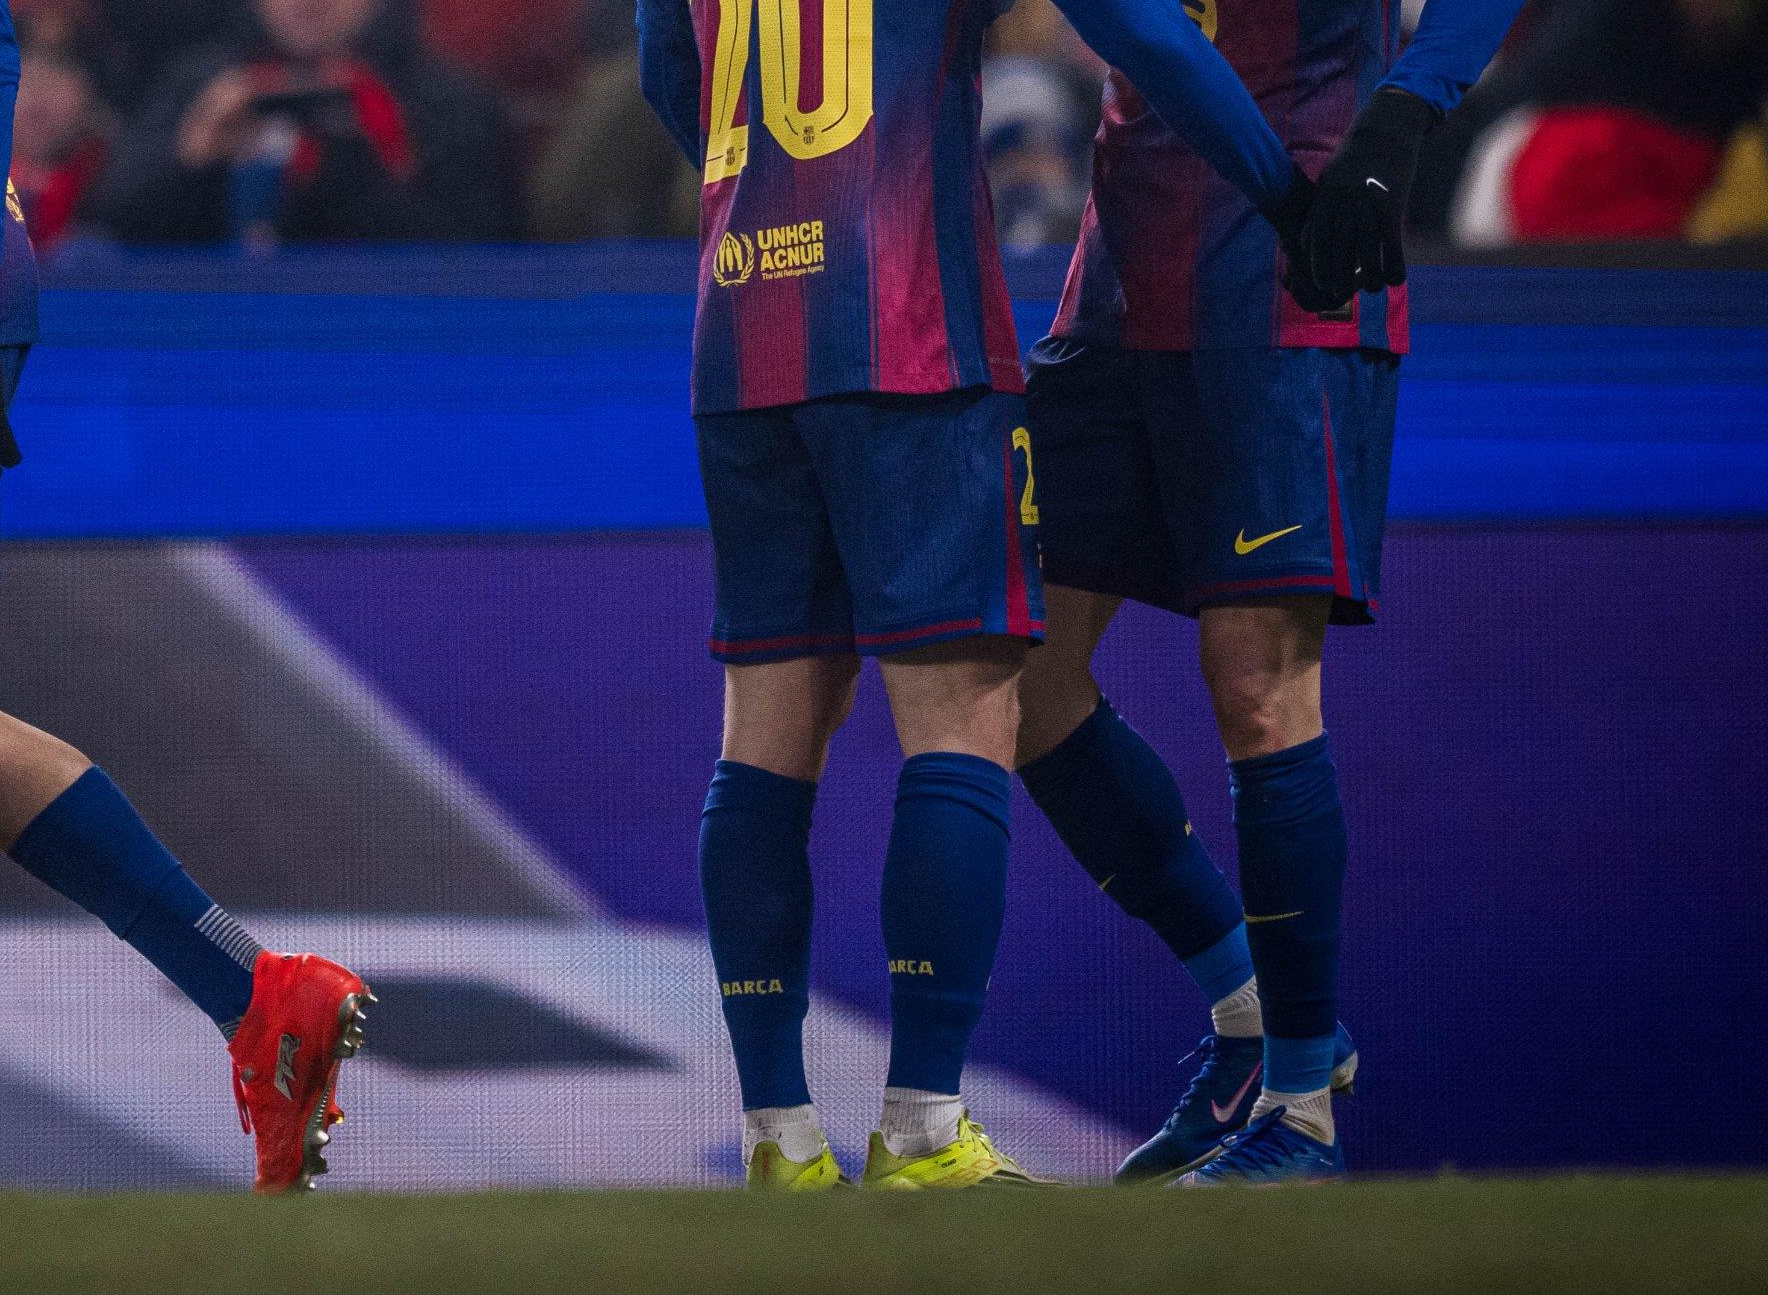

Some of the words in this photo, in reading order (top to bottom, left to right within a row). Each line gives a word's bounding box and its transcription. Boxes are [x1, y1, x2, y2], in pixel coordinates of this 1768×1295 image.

[756, 219, 824, 250] UNHCR
[760, 241, 825, 272] ACNUR
[1011, 426, 1041, 526] 2
